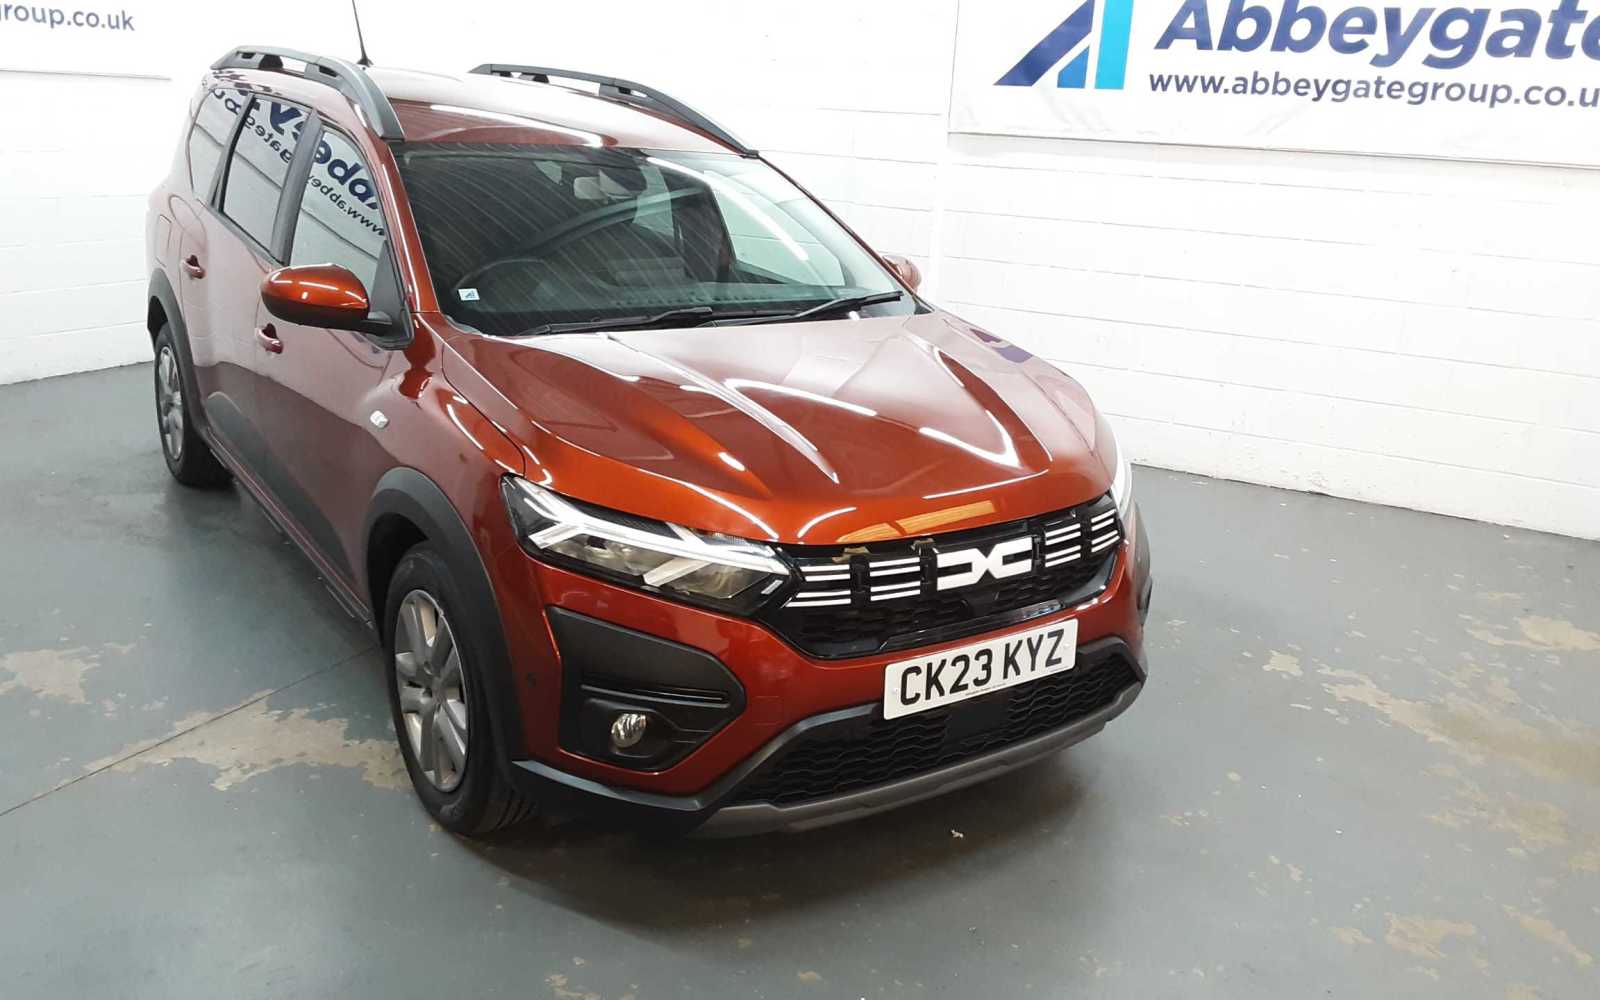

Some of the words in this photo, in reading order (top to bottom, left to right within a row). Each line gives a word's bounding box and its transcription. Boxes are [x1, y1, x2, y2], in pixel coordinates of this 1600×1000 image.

[0, 3, 135, 31] roup.co.uk
[900, 648, 993, 706] CK23
[1003, 628, 1065, 680] KYZ
